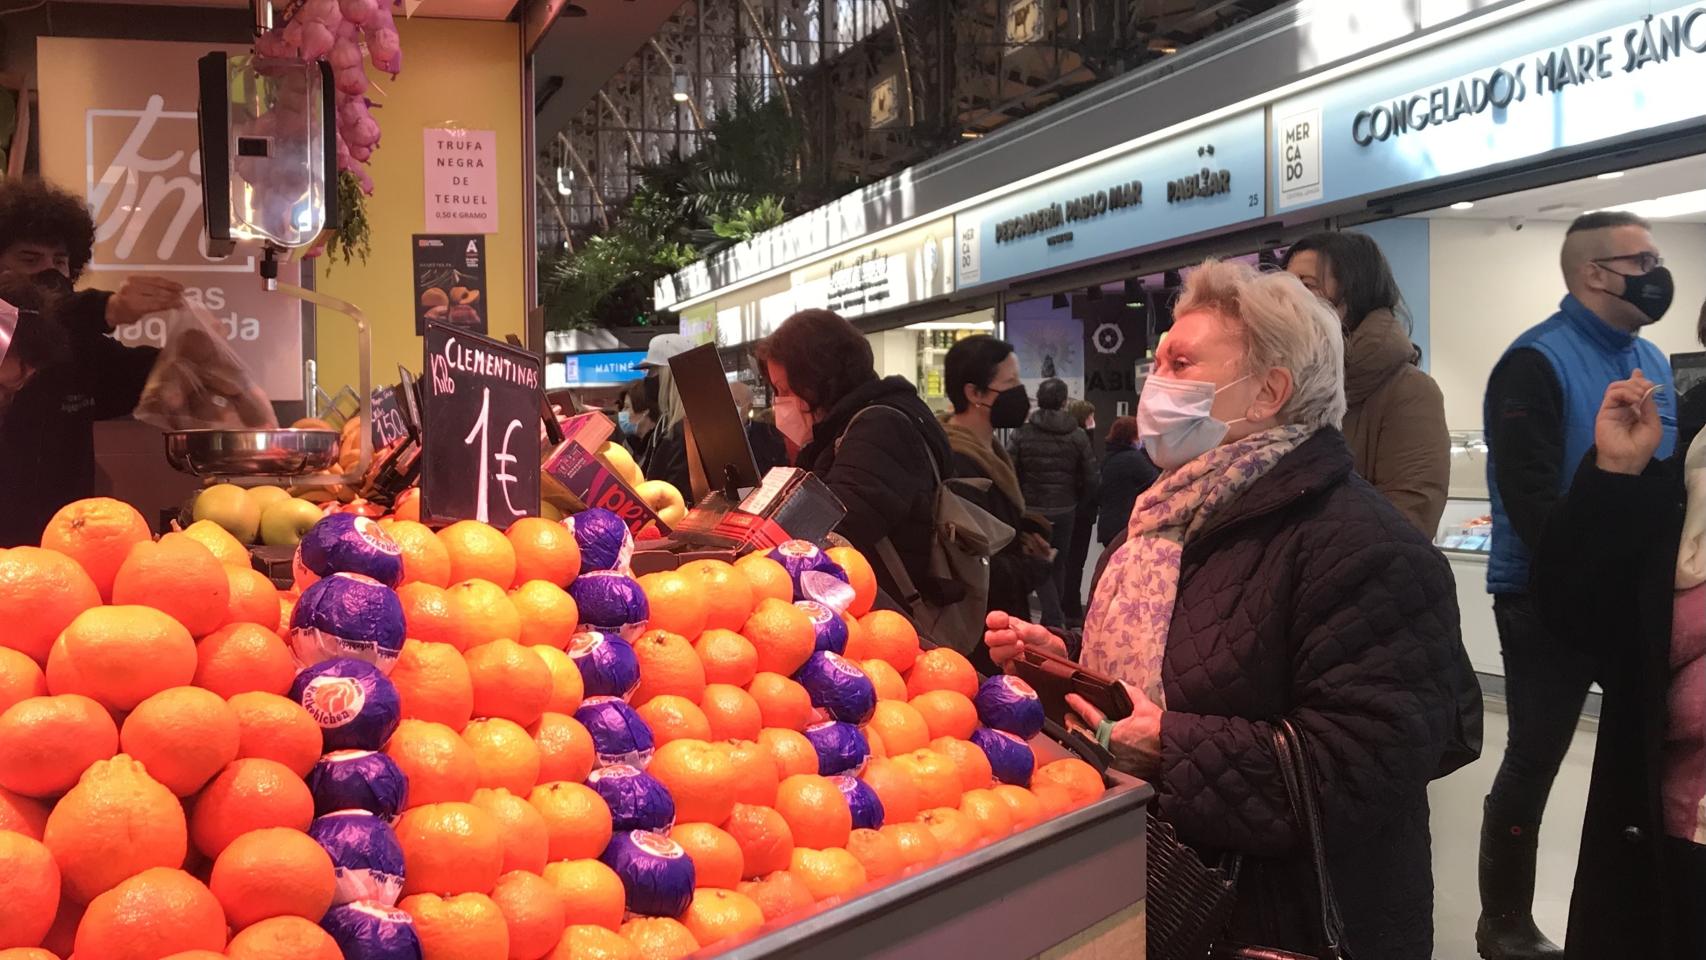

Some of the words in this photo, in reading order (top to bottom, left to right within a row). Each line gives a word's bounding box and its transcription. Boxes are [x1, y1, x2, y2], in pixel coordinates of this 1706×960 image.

[1352, 63, 1526, 147] CONGELADOS
[1536, 36, 1613, 96] MARE
[1286, 122, 1310, 144] MER
[437, 140, 482, 151] TRUFA
[1286, 145, 1301, 162] CA
[437, 158, 484, 168] NEGRA
[1286, 163, 1303, 181] DO
[452, 176, 469, 186] DE
[435, 194, 487, 205] TERUEL
[1066, 190, 1108, 224] PABLO
[1109, 180, 1143, 211] MAR
[1248, 194, 1259, 208] 25
[445, 336, 539, 390] CLEMENTINAS
[494, 418, 528, 516] €
